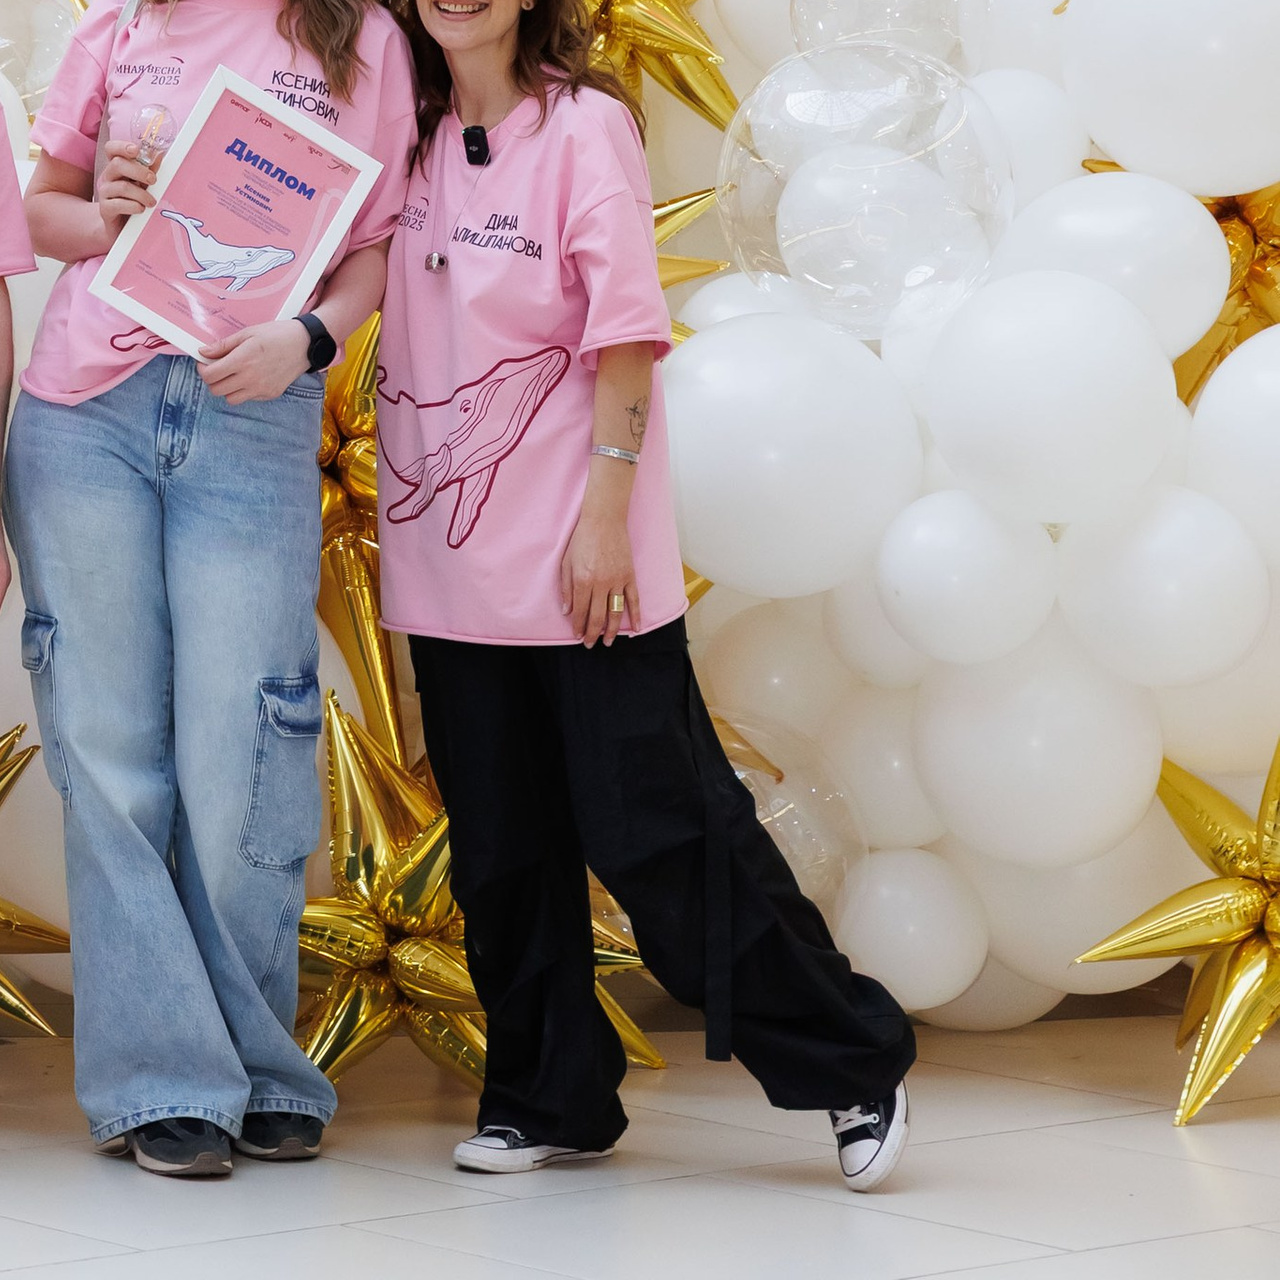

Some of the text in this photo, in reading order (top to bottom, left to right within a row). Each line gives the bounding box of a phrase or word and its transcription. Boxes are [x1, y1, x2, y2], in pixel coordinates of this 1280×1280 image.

[147, 64, 182, 75] ВЕСНА
[150, 75, 181, 86] 2025
[272, 70, 331, 98] КСЕНИЯ
[225, 138, 316, 201] Диплом
[243, 183, 271, 203] Ксения
[398, 214, 425, 232] 2025
[484, 213, 519, 231] ДИНА
